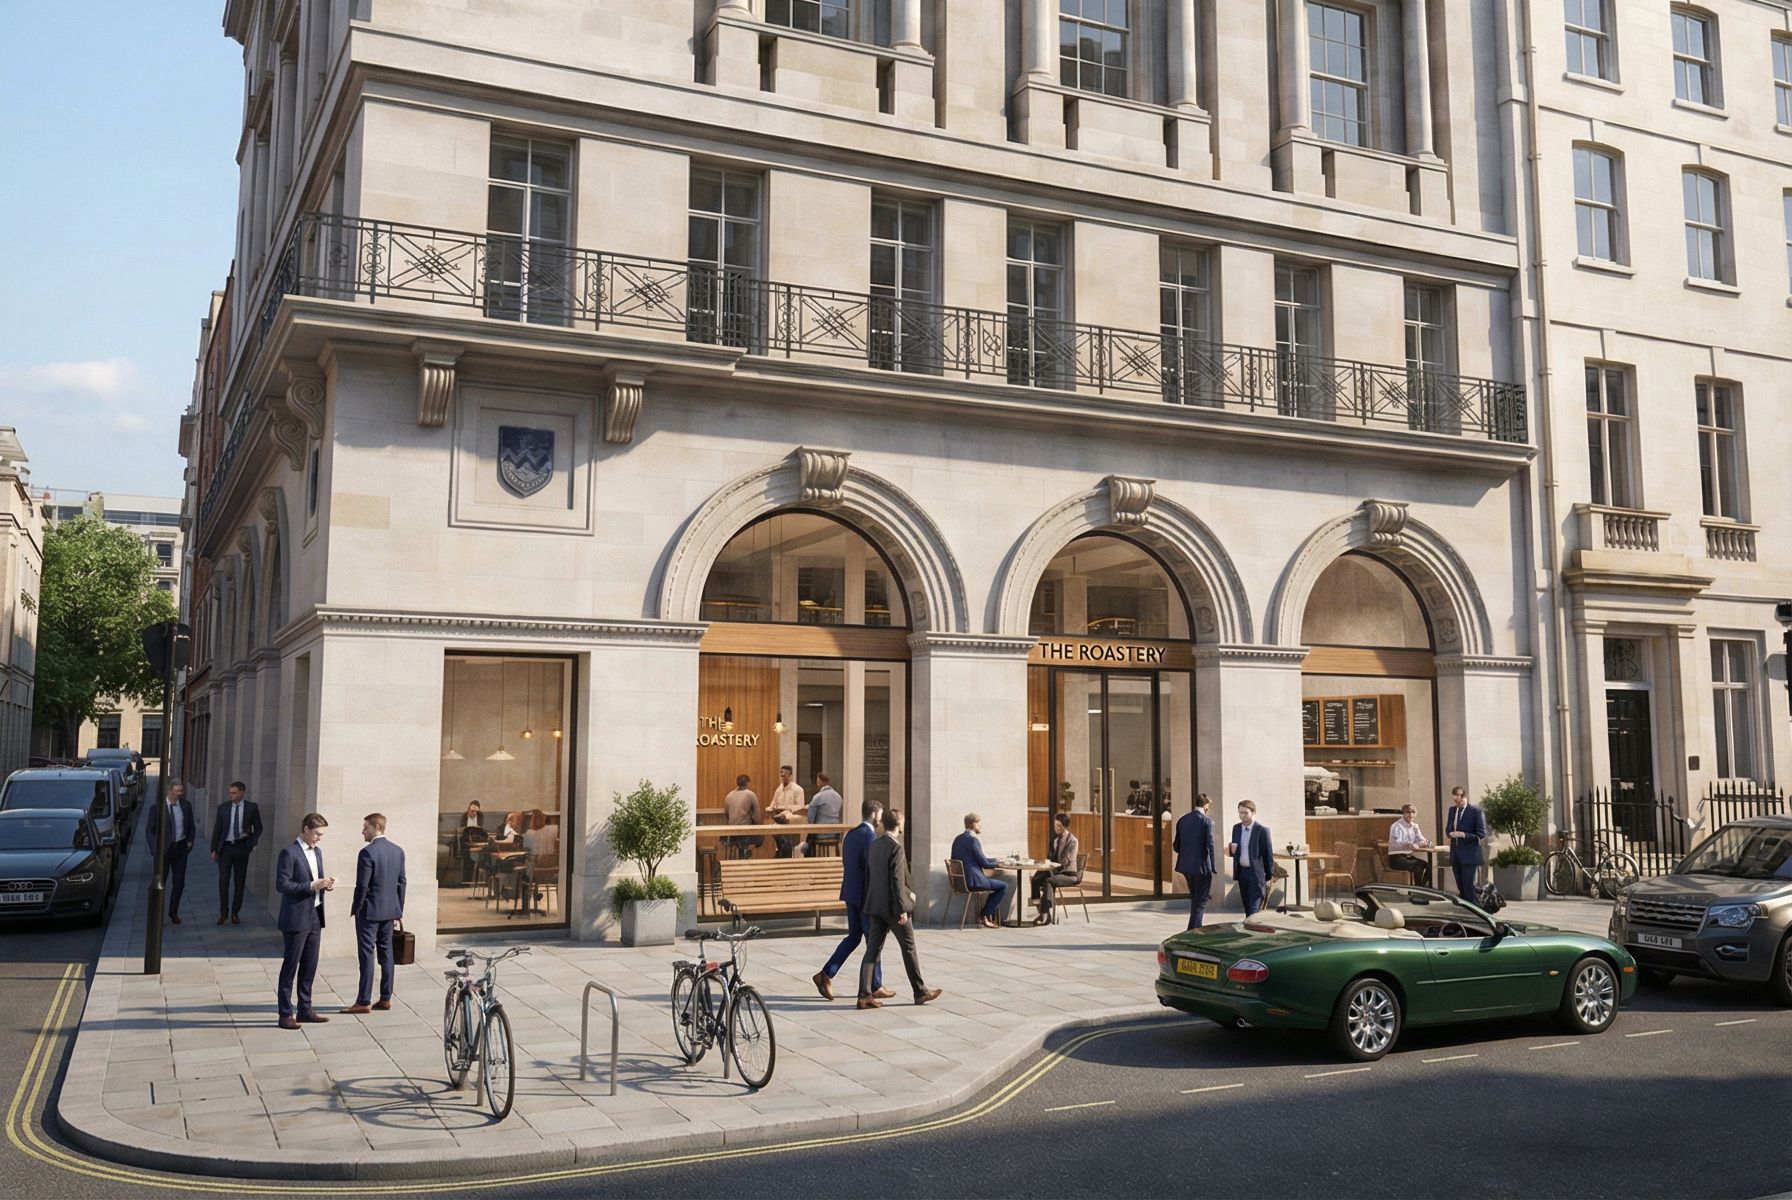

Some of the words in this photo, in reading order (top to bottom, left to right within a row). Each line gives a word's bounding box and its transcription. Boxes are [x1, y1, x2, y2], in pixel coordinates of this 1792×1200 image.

[1039, 643, 1073, 659] THE
[1079, 644, 1166, 663] ROASTERY
[696, 734, 759, 747] OASTERY
